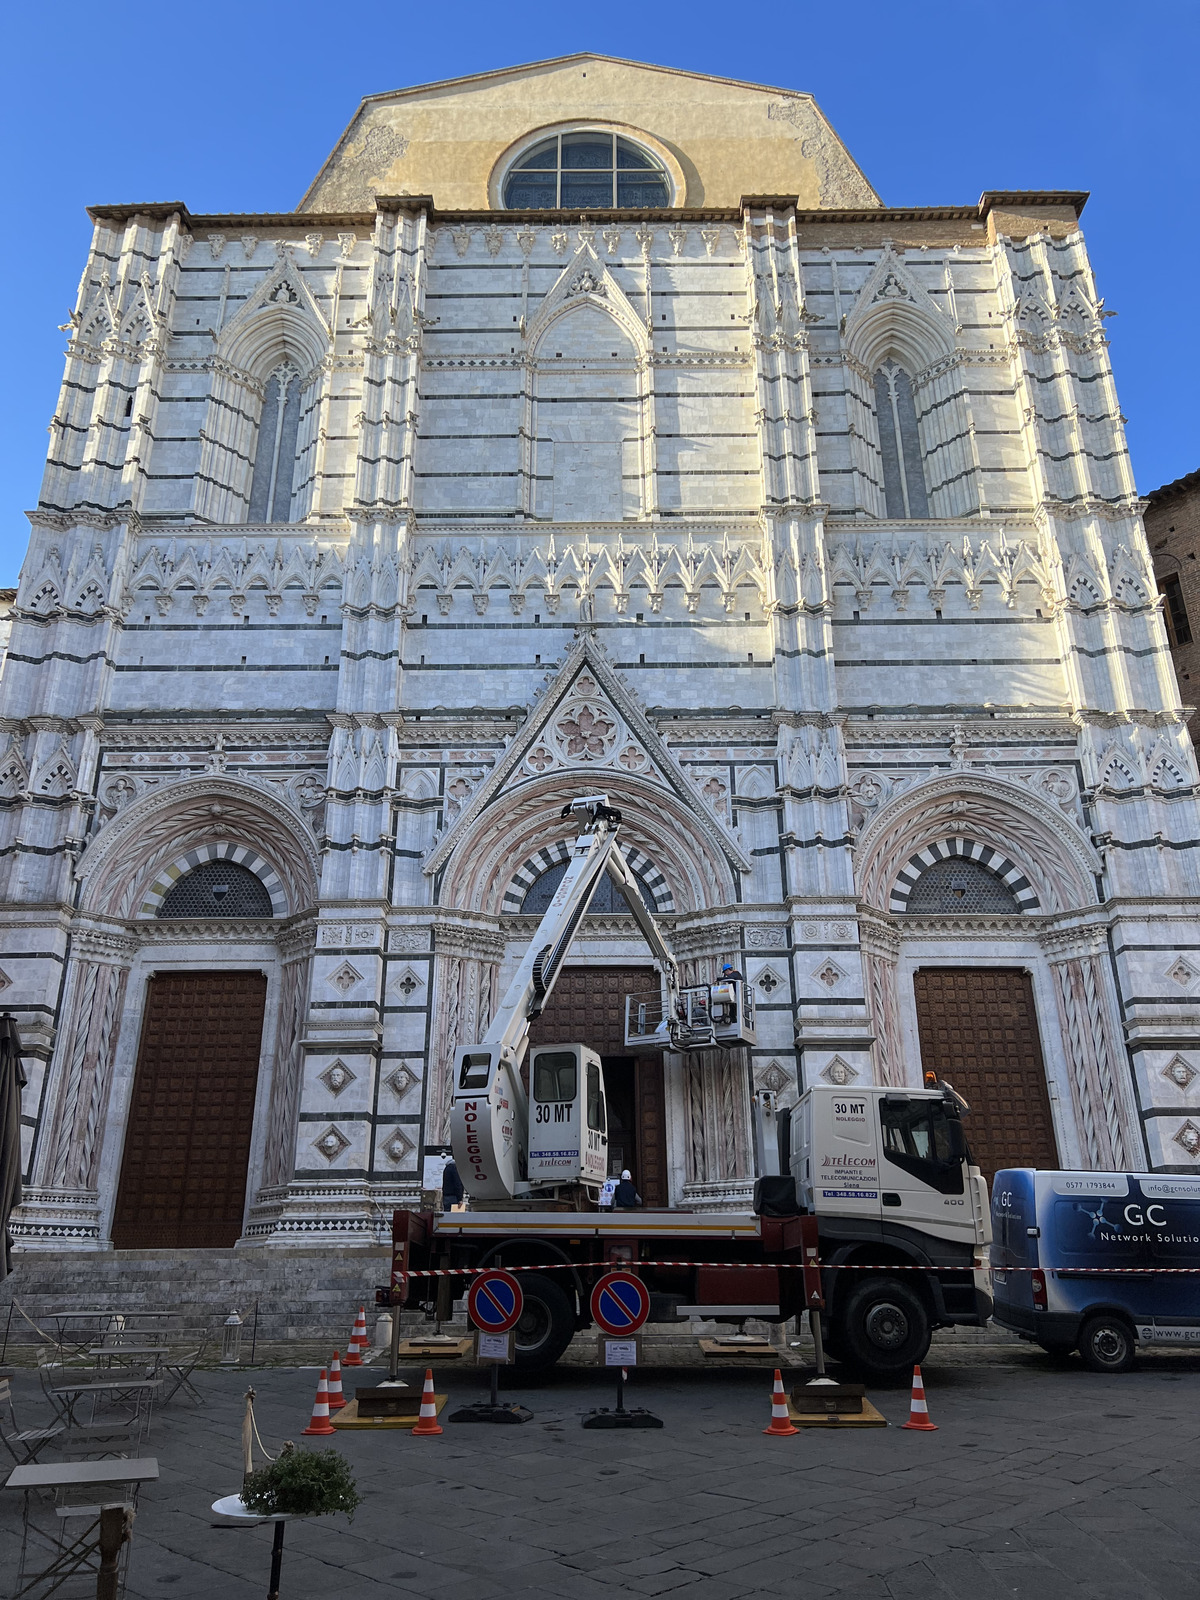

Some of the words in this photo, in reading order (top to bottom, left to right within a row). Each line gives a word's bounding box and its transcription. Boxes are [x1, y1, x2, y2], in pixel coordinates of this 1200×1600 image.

[535, 1104, 550, 1123] 30
[554, 1104, 573, 1123] MT
[834, 1103, 847, 1114] 30
[850, 1103, 865, 1114] MT
[464, 1101, 488, 1181] NOLEGGIO
[1001, 1191, 1013, 1207] GC
[1123, 1203, 1168, 1227] GC
[1100, 1232, 1152, 1242] Network
[1157, 1233, 1200, 1243] Solutio
